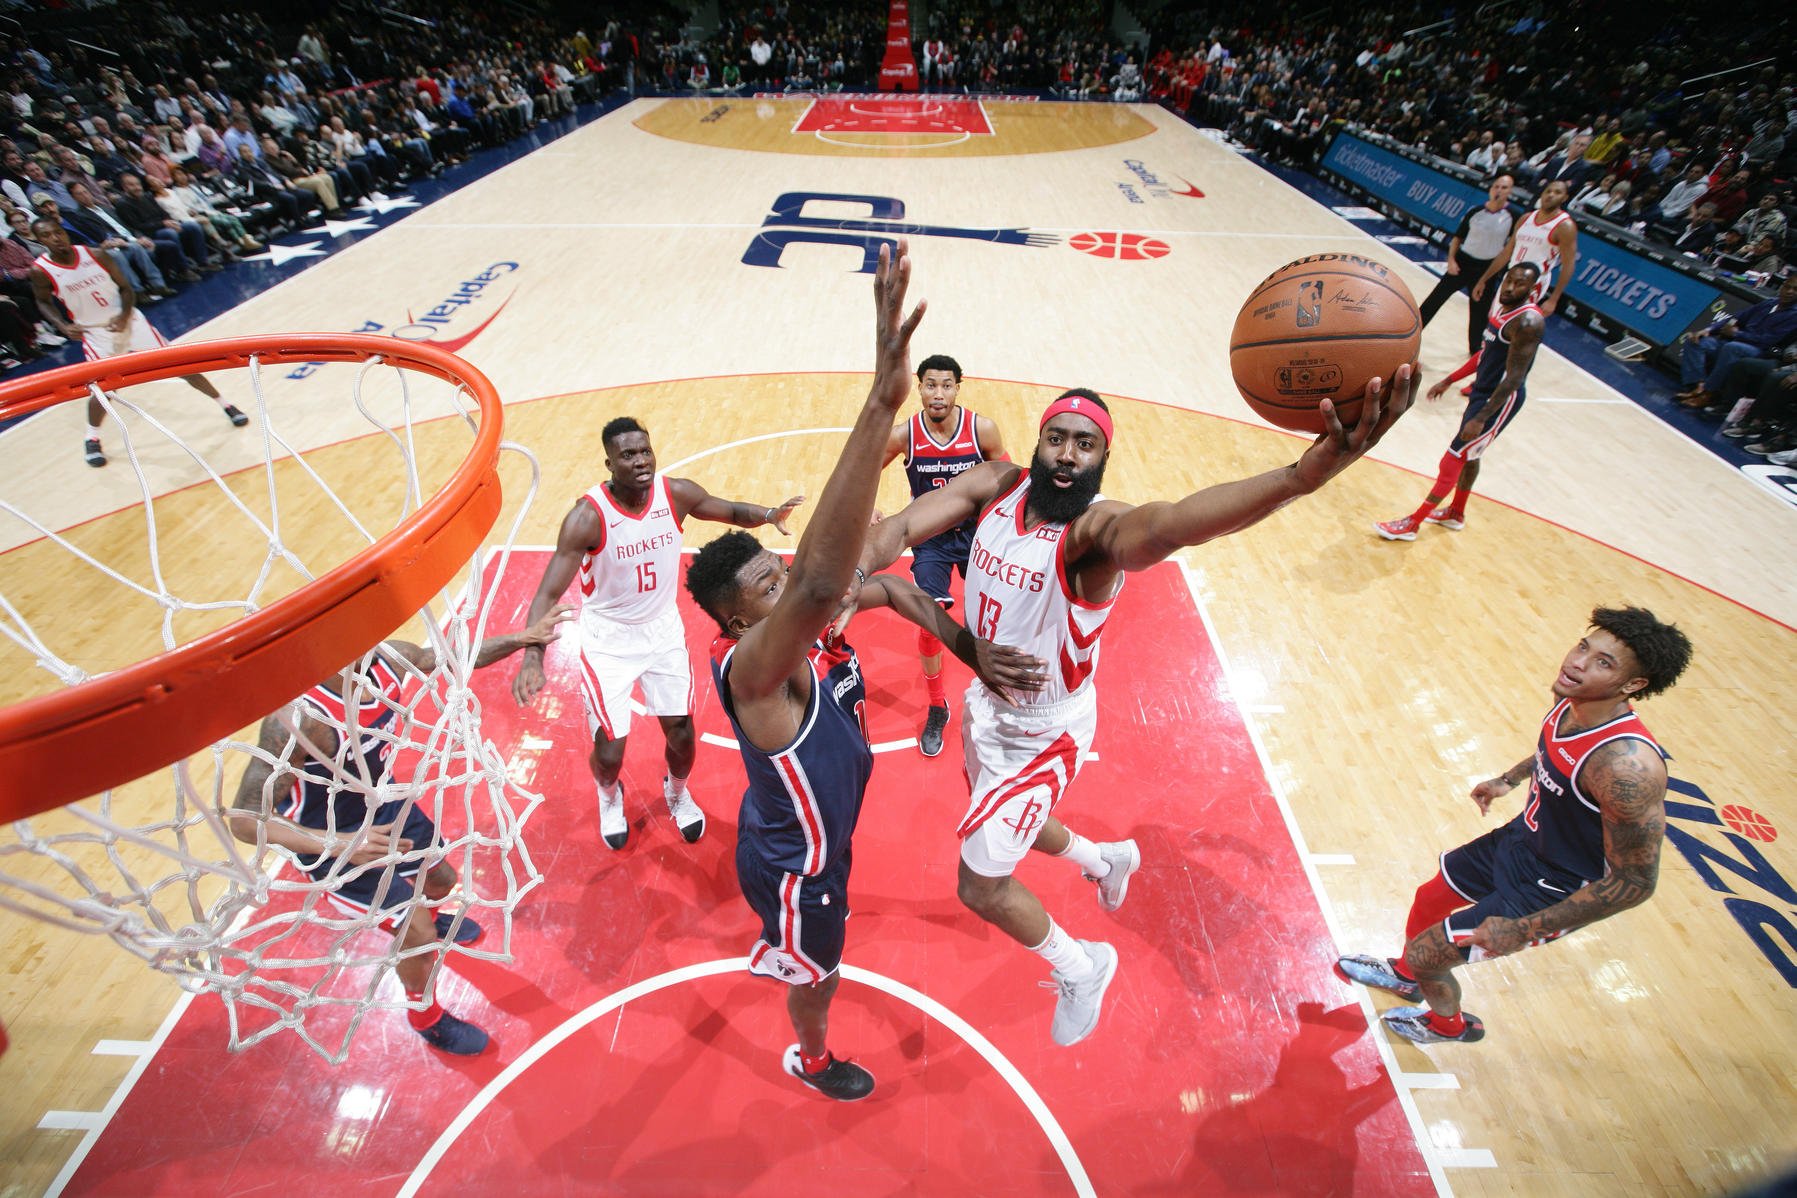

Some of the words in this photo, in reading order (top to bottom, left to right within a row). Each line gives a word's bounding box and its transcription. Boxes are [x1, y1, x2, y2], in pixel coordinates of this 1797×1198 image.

[1334, 143, 1401, 188] ticketmaster
[1407, 180, 1437, 204] BUY
[1431, 192, 1465, 218] AND
[1577, 258, 1677, 319] TICKETS
[91, 291, 109, 307] 6
[916, 460, 976, 475] washington
[616, 531, 674, 560] ROCKETS
[635, 561, 657, 594] 15
[972, 537, 1046, 593] ROCKETS
[976, 591, 1003, 643] 13
